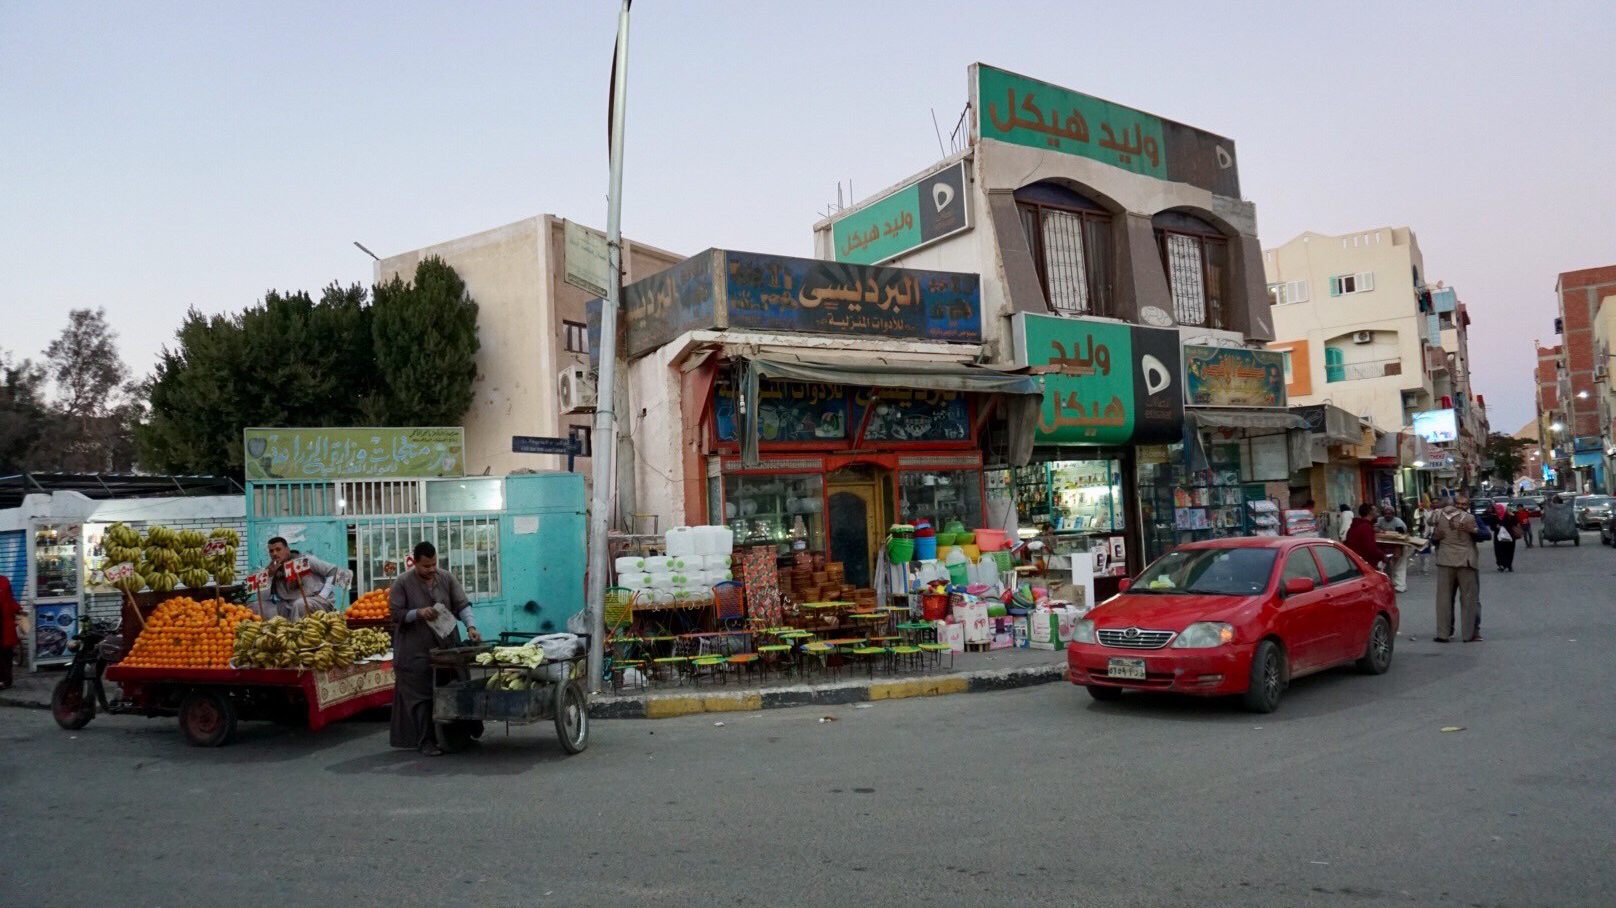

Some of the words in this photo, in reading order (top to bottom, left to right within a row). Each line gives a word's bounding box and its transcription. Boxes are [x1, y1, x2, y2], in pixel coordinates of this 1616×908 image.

[988, 88, 1090, 148] هيكل
[1100, 121, 1159, 167] وليد
[841, 224, 880, 257] هيكل
[882, 210, 914, 239] وليد
[1048, 334, 1111, 378] وليد
[1038, 391, 1126, 437] هيكل
